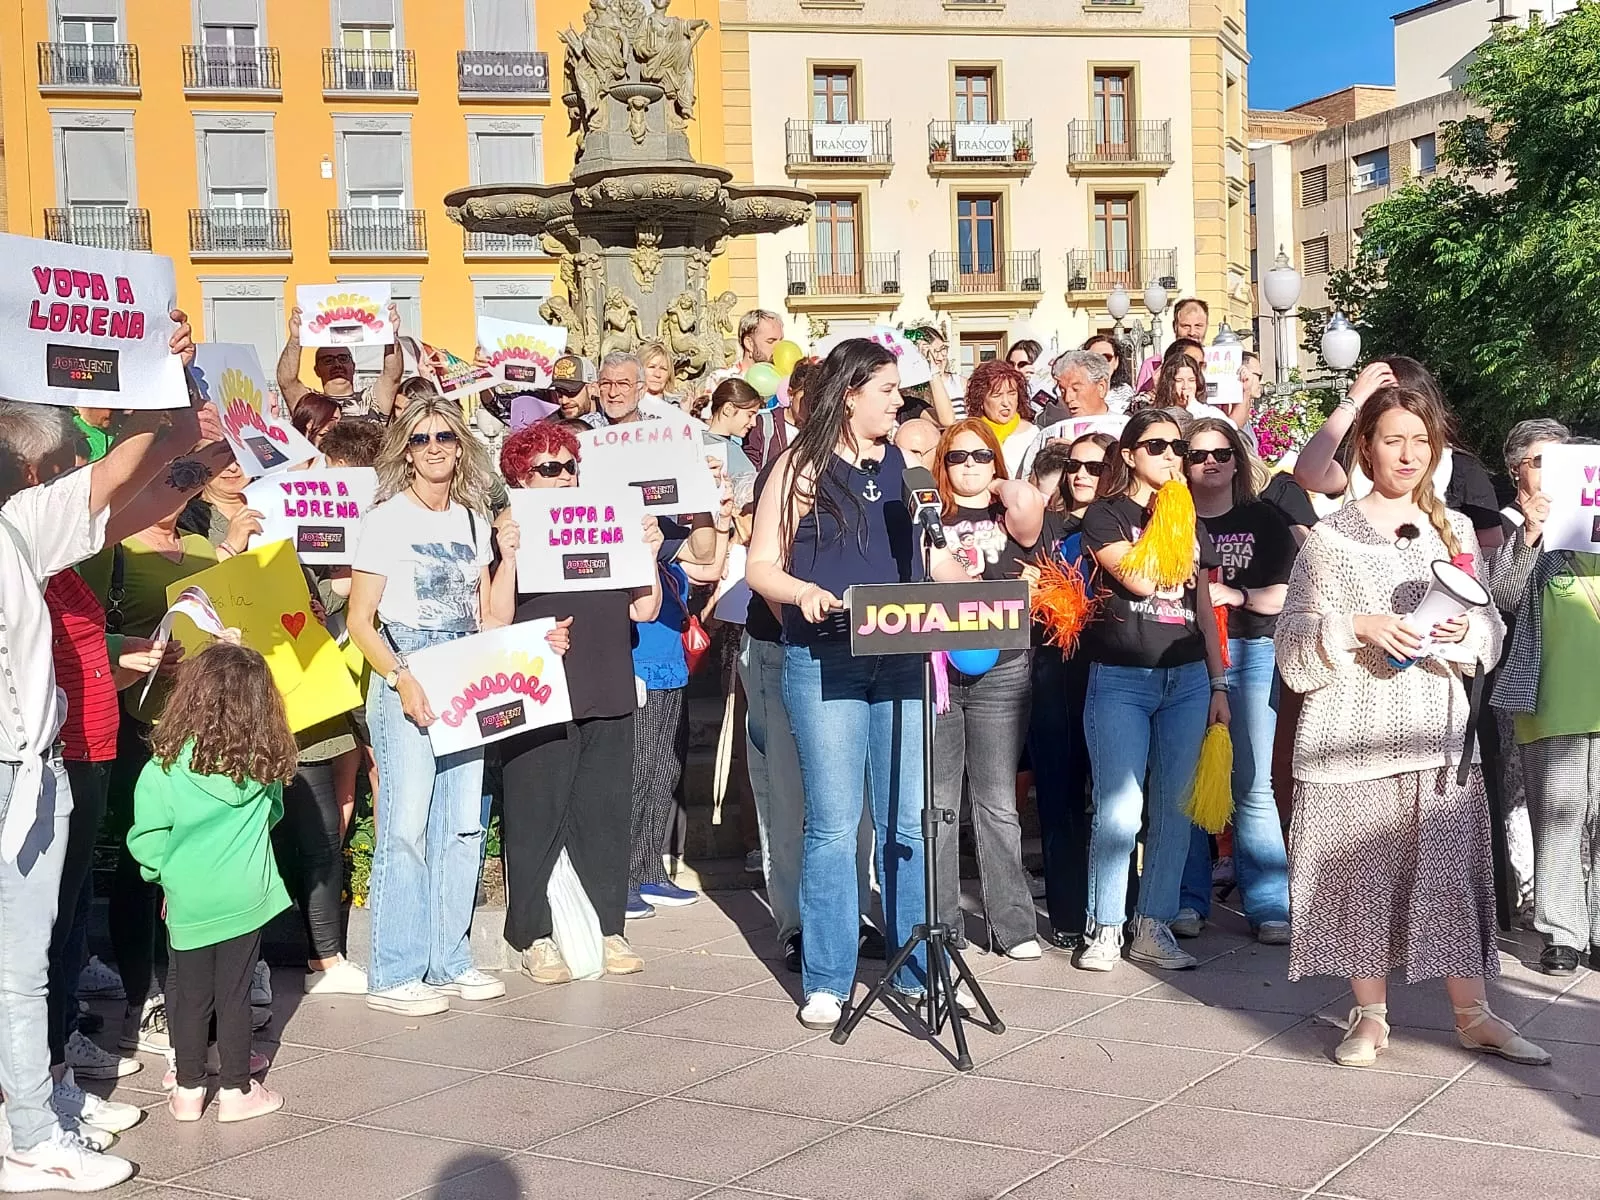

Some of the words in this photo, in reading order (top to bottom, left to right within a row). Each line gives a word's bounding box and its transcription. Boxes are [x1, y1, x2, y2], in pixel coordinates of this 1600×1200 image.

[463, 61, 545, 77] PODÓLOGO
[815, 139, 868, 153] FRANCOY
[958, 139, 1010, 153] FRANCOY
[32, 266, 109, 301] VOTA
[115, 276, 135, 304] A
[28, 299, 145, 339] LORENA
[52, 357, 113, 374] JOTALENT
[70, 371, 93, 381] 2024
[593, 427, 673, 447] LORENA
[682, 423, 692, 441] A
[280, 481, 331, 496] VOTA
[337, 481, 348, 496] A
[284, 499, 359, 518] LORENA
[550, 506, 597, 524] VOTA
[604, 505, 615, 522] A
[549, 527, 624, 546] LORENA
[1217, 533, 1255, 544] MATA
[1226, 567, 1236, 580] 3
[857, 600, 1025, 636] JOTALENT
[441, 672, 552, 728] GANADORA
